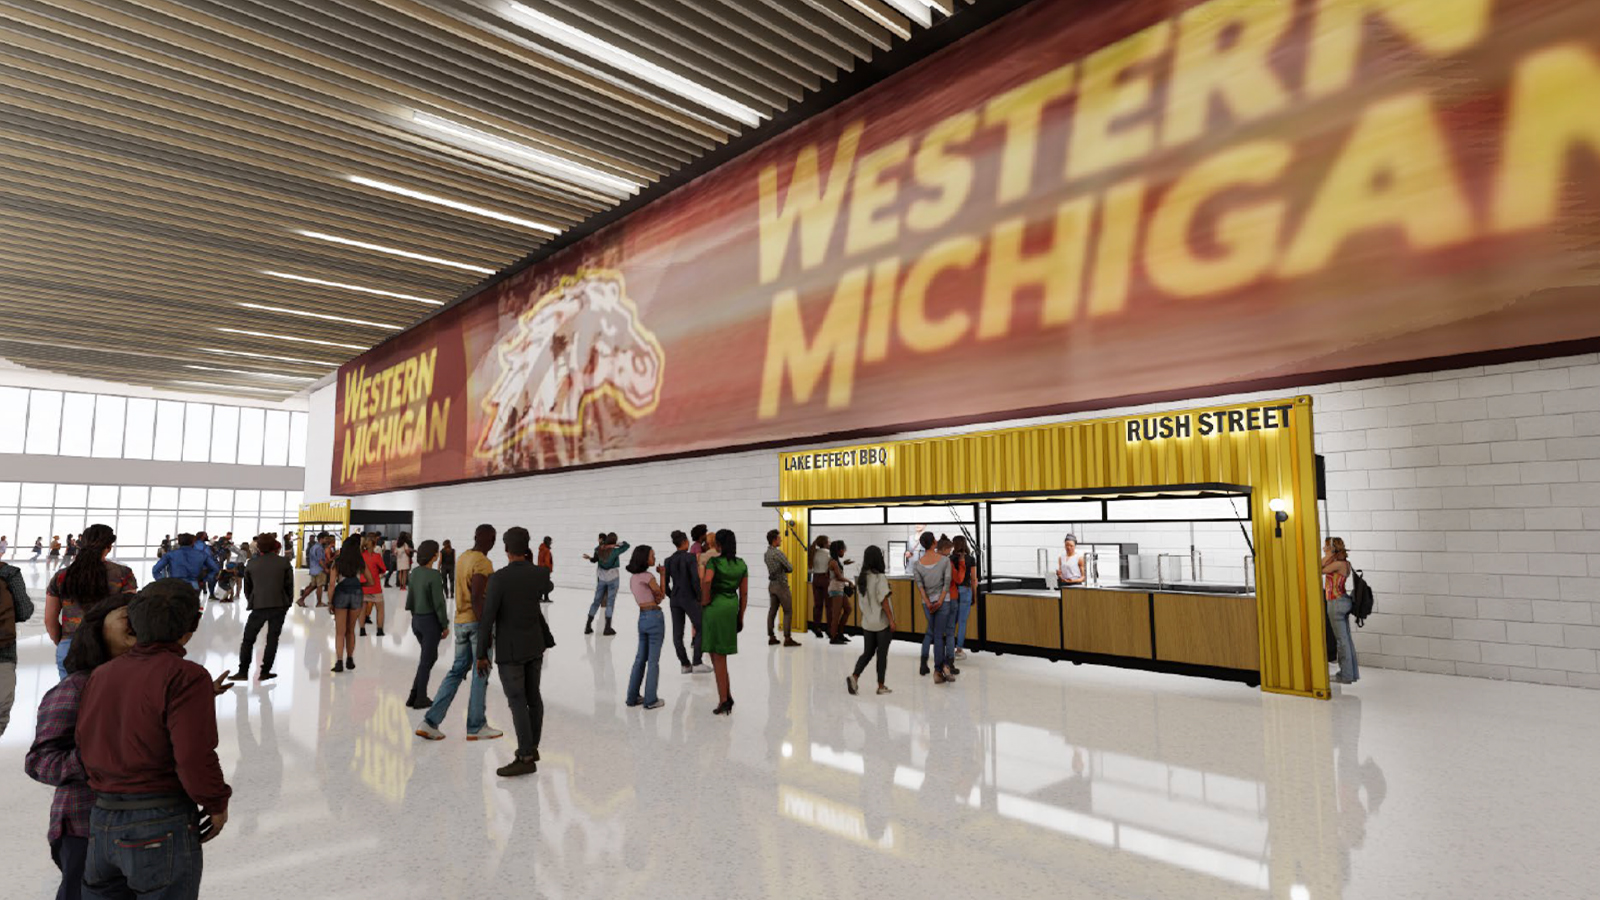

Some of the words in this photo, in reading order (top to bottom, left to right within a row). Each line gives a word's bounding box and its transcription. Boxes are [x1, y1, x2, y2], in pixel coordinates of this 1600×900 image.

[343, 347, 438, 426] WESTERN
[340, 397, 452, 486] MICHIGAN
[1127, 414, 1190, 442] RUSH
[1198, 404, 1293, 436] STREET
[784, 454, 812, 471] LAKE
[813, 449, 857, 469] EFFECT
[859, 447, 888, 467] BBQ
